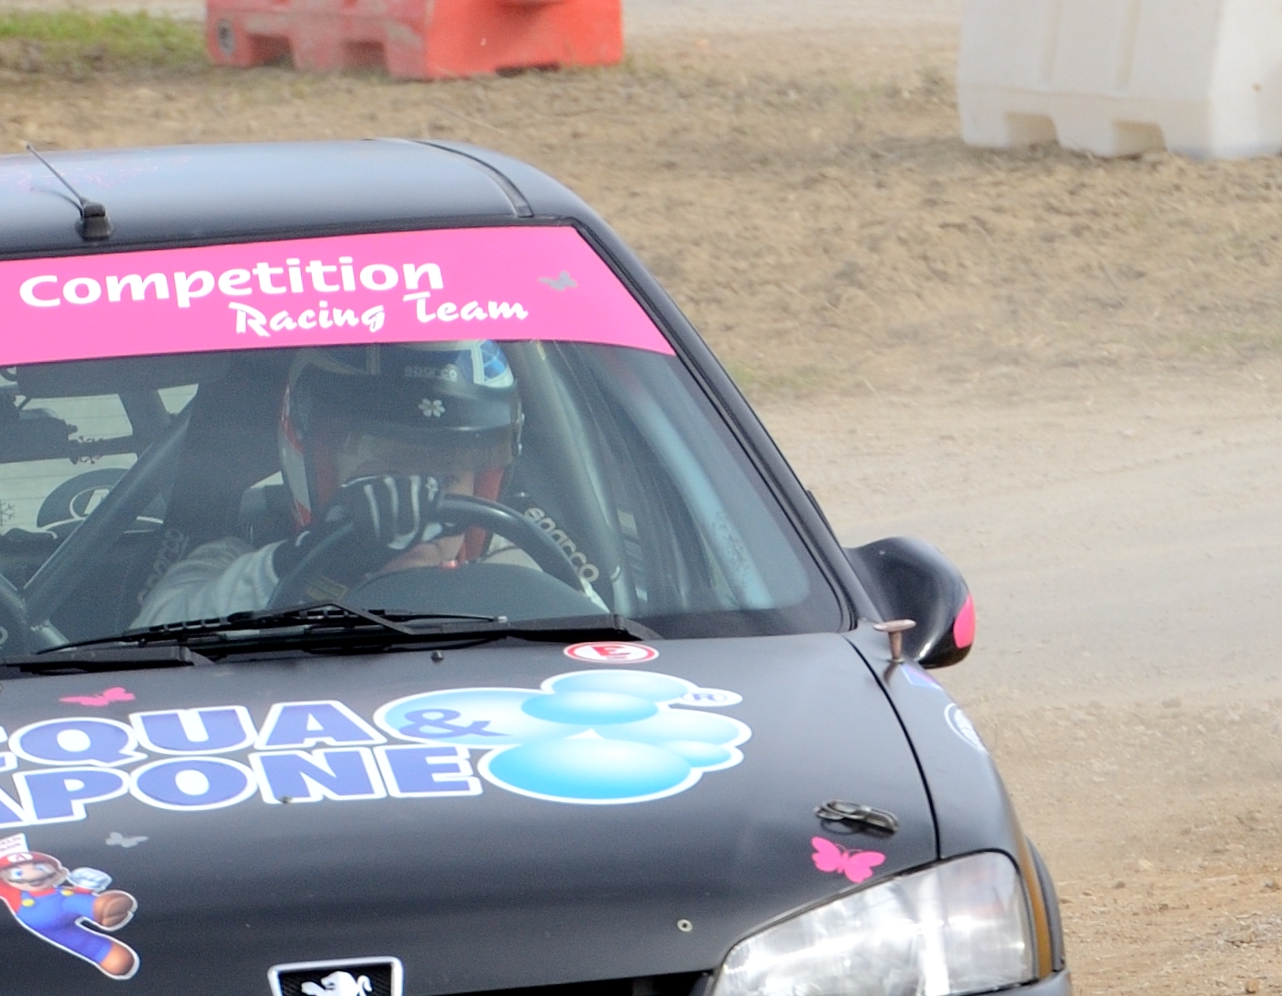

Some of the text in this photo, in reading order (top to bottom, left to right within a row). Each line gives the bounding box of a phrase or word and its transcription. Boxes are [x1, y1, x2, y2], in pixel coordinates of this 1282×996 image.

[19, 254, 444, 312] Competition
[229, 291, 529, 337] Racing Team
[397, 707, 510, 740] &
